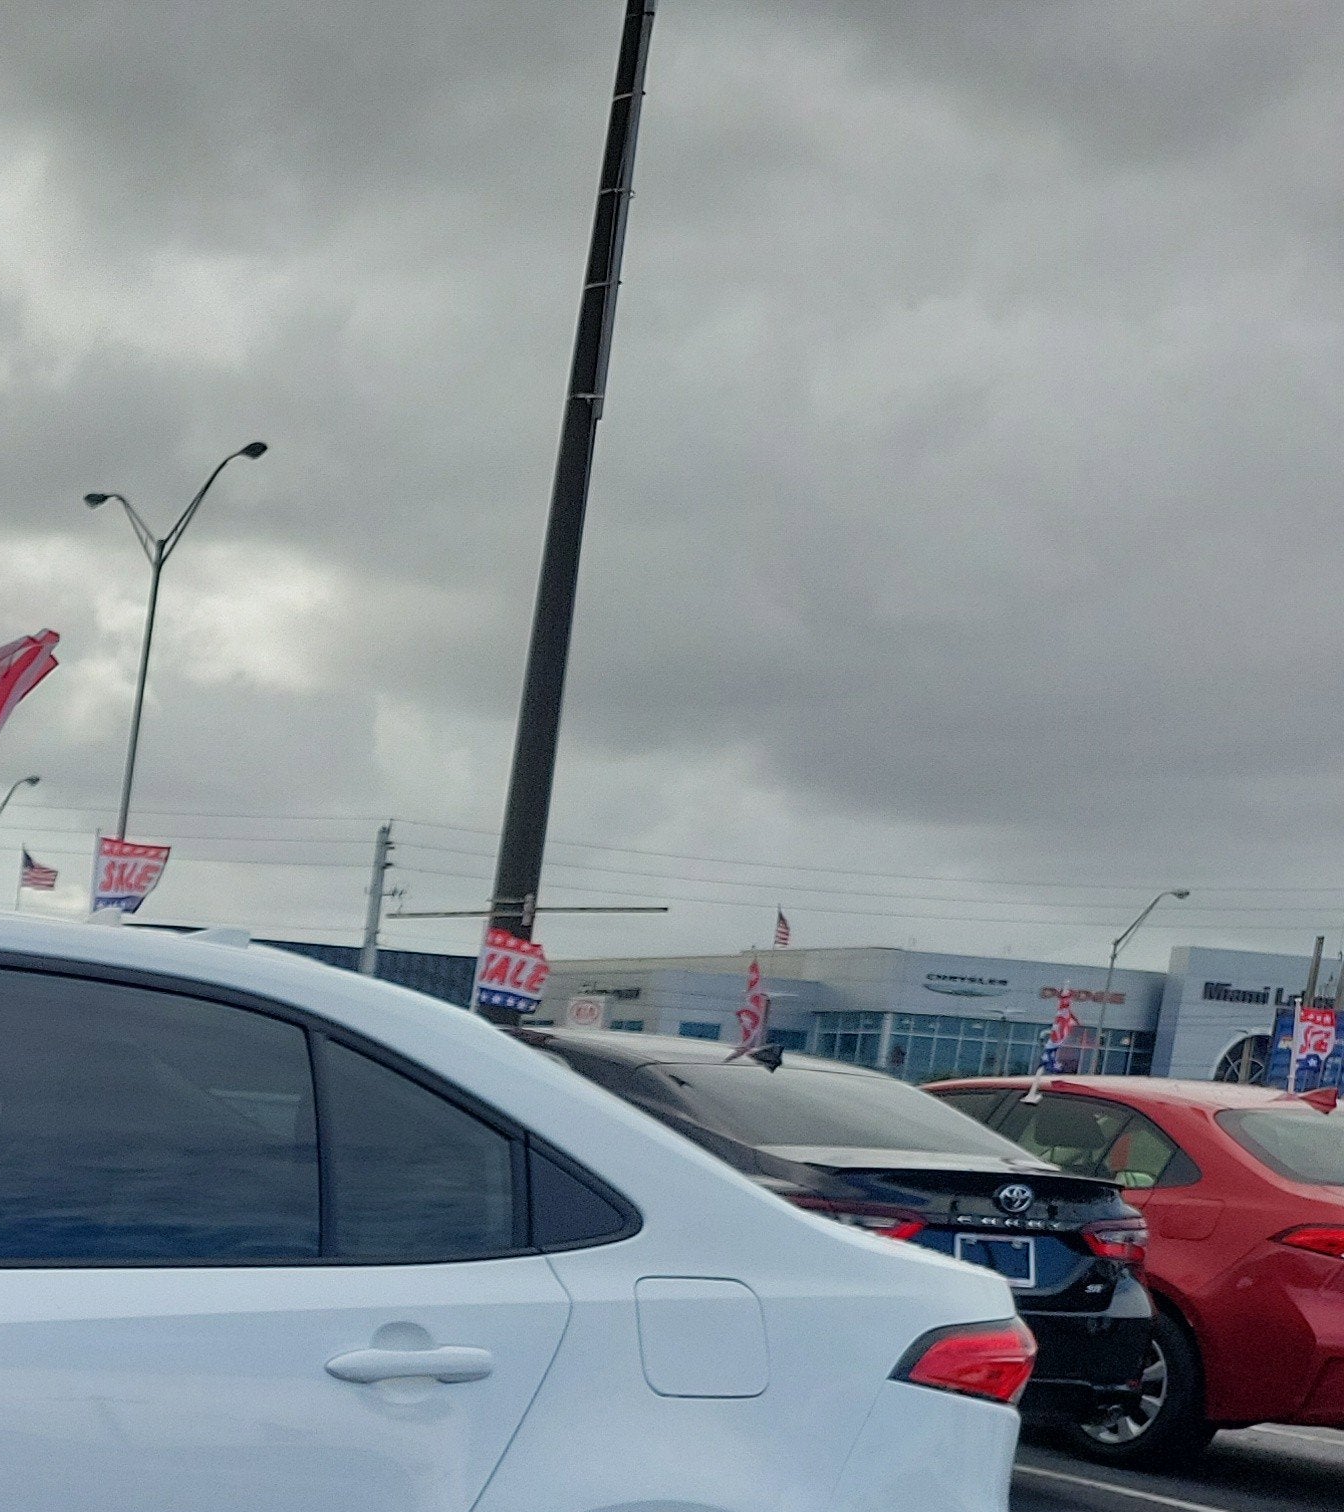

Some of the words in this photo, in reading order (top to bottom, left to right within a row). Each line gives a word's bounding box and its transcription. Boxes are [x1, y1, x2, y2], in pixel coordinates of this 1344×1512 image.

[926, 973, 1009, 987] CHRYSLER
[1040, 986, 1127, 1005] DDGE
[1203, 981, 1271, 1005] Miami
